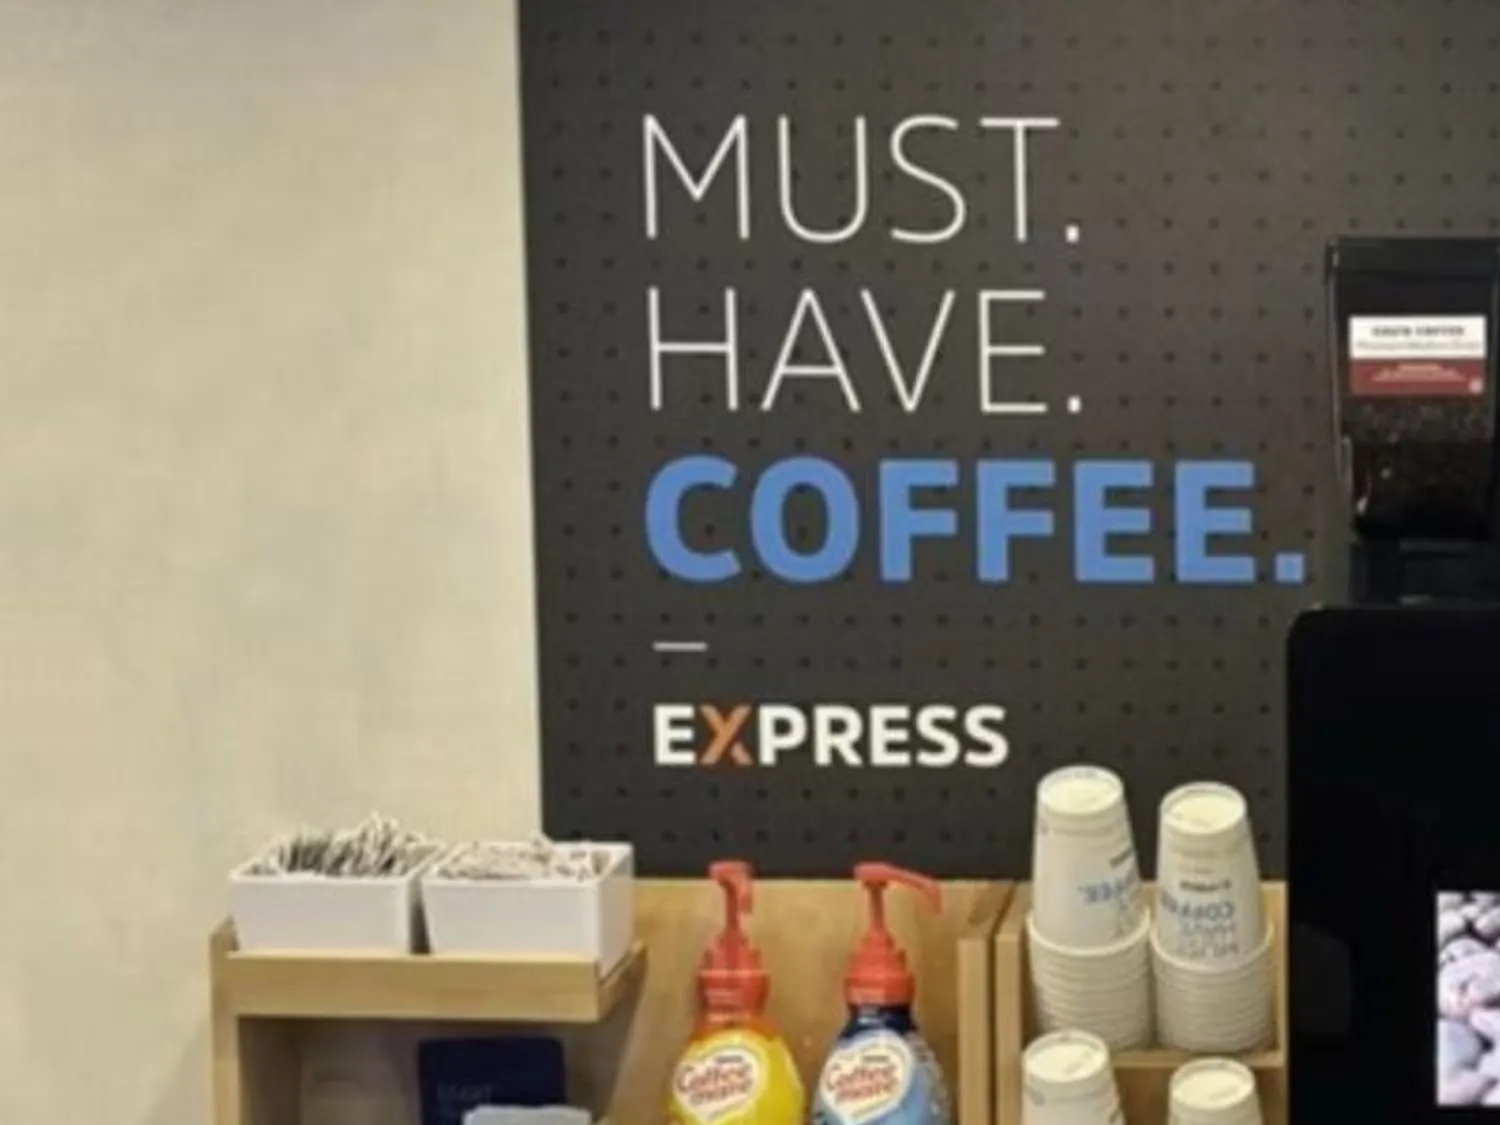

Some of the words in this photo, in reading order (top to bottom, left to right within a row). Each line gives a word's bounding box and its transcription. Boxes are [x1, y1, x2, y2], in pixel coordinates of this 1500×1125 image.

[643, 114, 1080, 243] MUST.
[648, 286, 1082, 413] HAVE.
[645, 454, 1306, 584] COFFEE.
[653, 703, 1009, 766] EXPRESS
